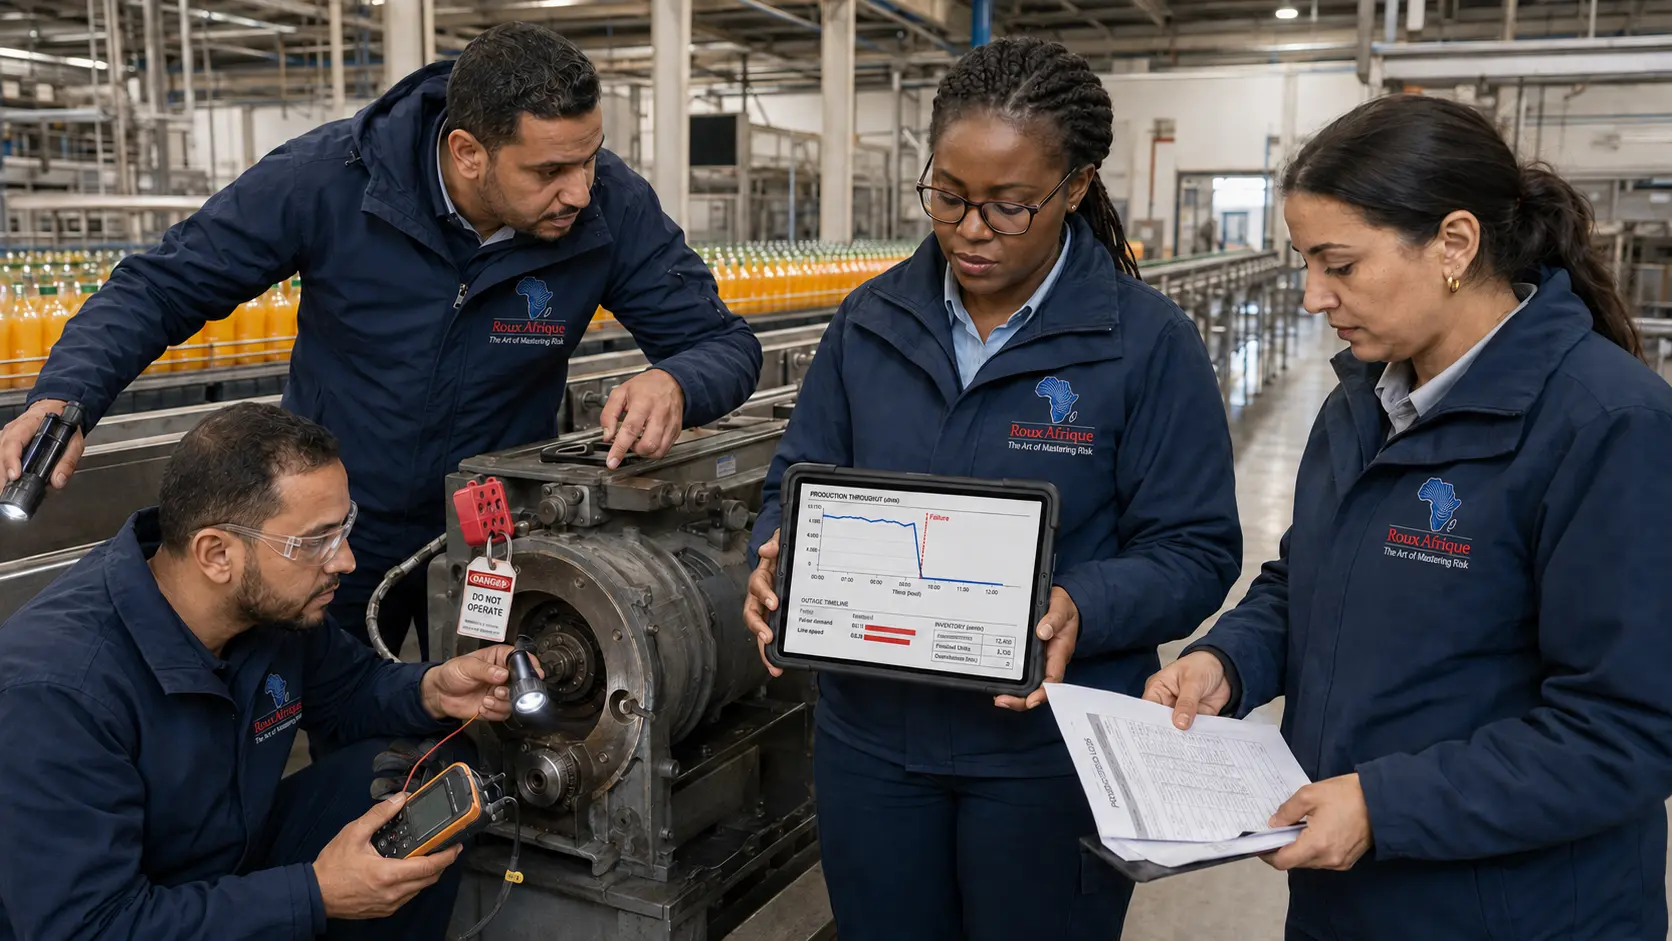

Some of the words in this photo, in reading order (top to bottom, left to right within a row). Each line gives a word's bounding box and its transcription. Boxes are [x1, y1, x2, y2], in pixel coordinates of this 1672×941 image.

[492, 320, 521, 332] Roux
[522, 321, 566, 336] Afrique
[489, 336, 500, 344] The
[1009, 424, 1043, 438] Roux
[1044, 426, 1094, 444] Afrique
[1008, 441, 1020, 449] The
[1021, 442, 1032, 450] Art
[1033, 443, 1041, 451] of
[810, 491, 847, 500] PRODUCTION
[1387, 527, 1420, 546] Roux
[1420, 534, 1471, 555] Afrique
[1383, 546, 1396, 557] The
[1397, 549, 1408, 558] Art
[1408, 551, 1417, 560] of
[472, 592, 484, 602] DO
[485, 595, 502, 605] NOT
[824, 599, 849, 607] TIMELINE
[467, 603, 503, 617] OPERATE
